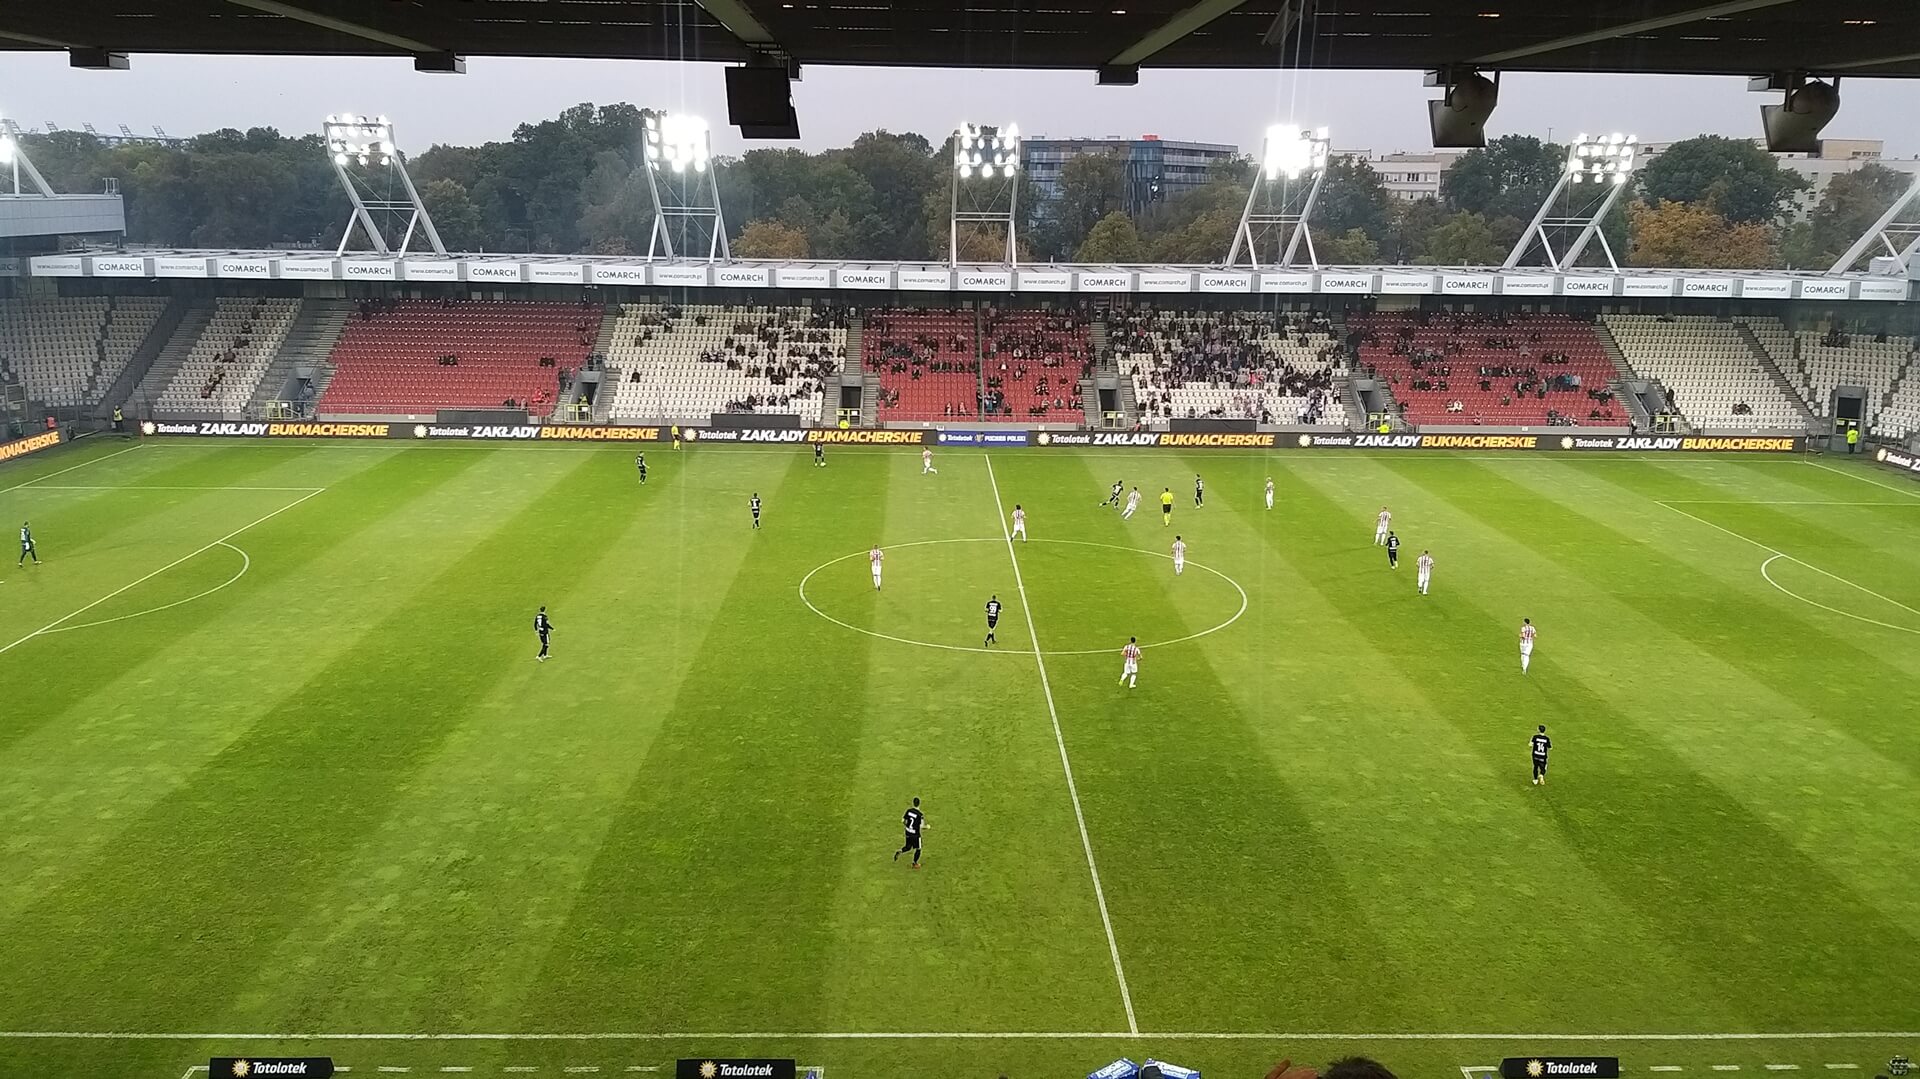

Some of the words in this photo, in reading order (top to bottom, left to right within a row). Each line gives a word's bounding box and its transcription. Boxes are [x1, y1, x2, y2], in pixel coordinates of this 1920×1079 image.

[37, 262, 80, 270] www.comarch.pl
[98, 263, 141, 272] COMARCH
[160, 263, 204, 271] www.comarch.pl
[223, 264, 266, 272] COMARCH
[348, 267, 391, 275] COMARCH
[472, 268, 516, 277] COMARCH
[596, 271, 640, 279] COMARCH
[720, 274, 764, 282] COMARCH
[843, 275, 885, 284] COMARCH
[963, 278, 1005, 286] COMARCH
[1084, 279, 1126, 287] COMARCH
[1204, 279, 1246, 287] COMARCH
[1325, 280, 1367, 288] COMARCH
[1446, 281, 1488, 289] COMARCH
[1567, 283, 1609, 291] COMARCH
[1686, 284, 1728, 292] COMARCH
[1804, 286, 1846, 294] COMARCH
[157, 423, 196, 434] Totolotek
[200, 423, 268, 435] ZAKŁADY
[269, 425, 389, 437] BUKMACHERSKIE
[428, 427, 468, 436] Totolotek
[471, 426, 540, 438] ZAKŁADY
[540, 427, 658, 439] BUKMACHERSKIE
[698, 430, 737, 440] Totolotek
[740, 430, 808, 442] ZAKŁADY
[808, 431, 922, 443] BUKMACHERSKIE
[1051, 434, 1090, 444] Totolotek
[1093, 434, 1160, 445] ZAKŁADY
[1160, 434, 1274, 446] BUKMACHERSKIE
[1313, 436, 1351, 445] Totolotek
[1354, 435, 1421, 446] ZAKŁADY
[1421, 436, 1537, 448] BUKMACHERSKIE
[1576, 438, 1612, 447] Totolotek
[1616, 438, 1683, 449] ZAKŁADY
[1683, 438, 1793, 450] BUKMACHERSKIE
[253, 1062, 307, 1074] Totolotek
[720, 1064, 773, 1076] Totolotek
[1546, 1062, 1598, 1074] Totolotek
